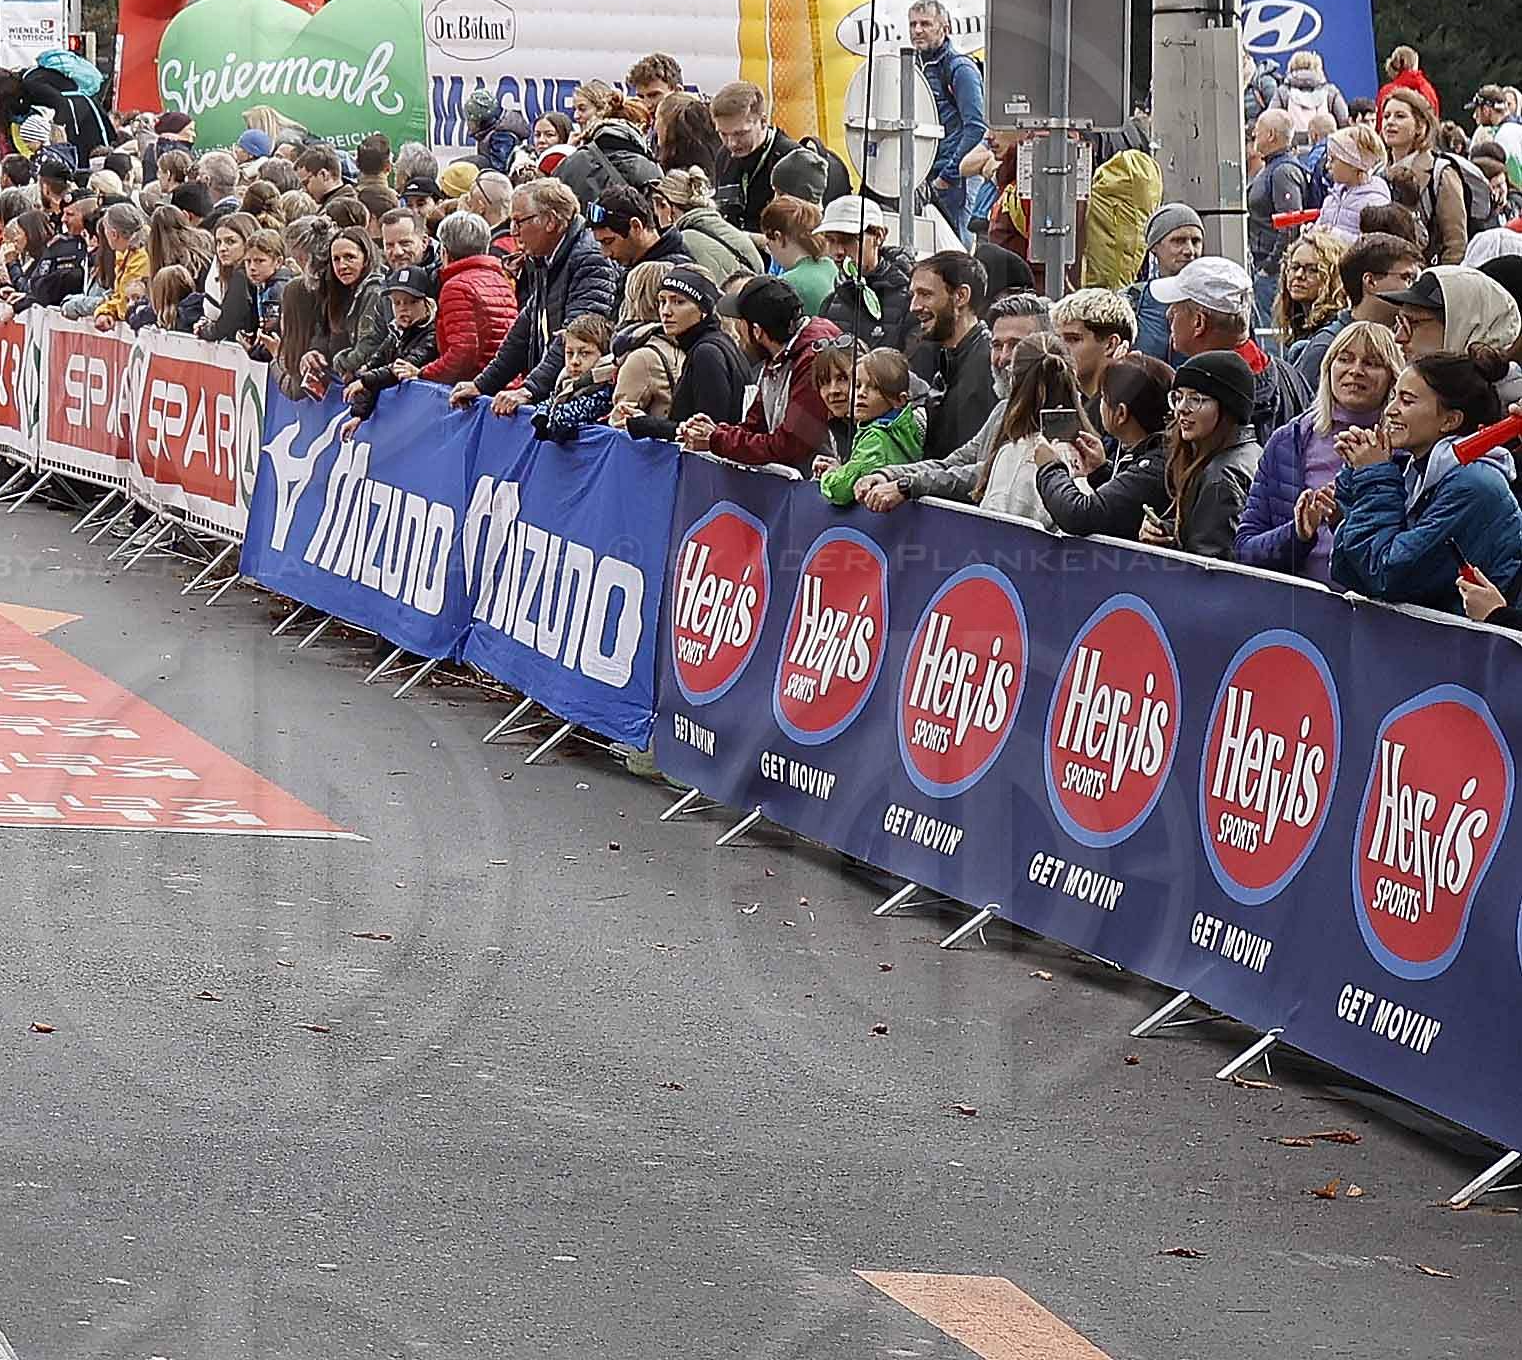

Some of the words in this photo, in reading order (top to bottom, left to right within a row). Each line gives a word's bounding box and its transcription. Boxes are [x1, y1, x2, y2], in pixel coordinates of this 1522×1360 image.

[9, 26, 40, 34] WIENER
[434, 15, 457, 40] Dr.
[856, 17, 901, 52] Dr.
[161, 41, 405, 115] Steiermark
[662, 276, 705, 303] GARMIN
[64, 353, 134, 442] SPA
[147, 378, 237, 481] SPAR
[675, 541, 757, 660] Hervis
[676, 635, 705, 666] SPORTS
[794, 577, 876, 683] Hervis
[783, 674, 815, 704] SPORTS
[909, 612, 1017, 745] Hervis
[912, 720, 952, 756] SPORTS
[1056, 645, 1173, 792] Hervis
[760, 751, 786, 781] GET
[1062, 761, 1107, 802] SPORTS
[1214, 685, 1327, 853] Hervis
[883, 803, 910, 836] GET
[1217, 811, 1261, 853] SPORTS
[1367, 739, 1490, 903] Hervis
[1029, 851, 1061, 885] GET
[1372, 876, 1423, 924] SPORTS
[1190, 911, 1223, 948] GET
[1336, 983, 1371, 1024] GET
